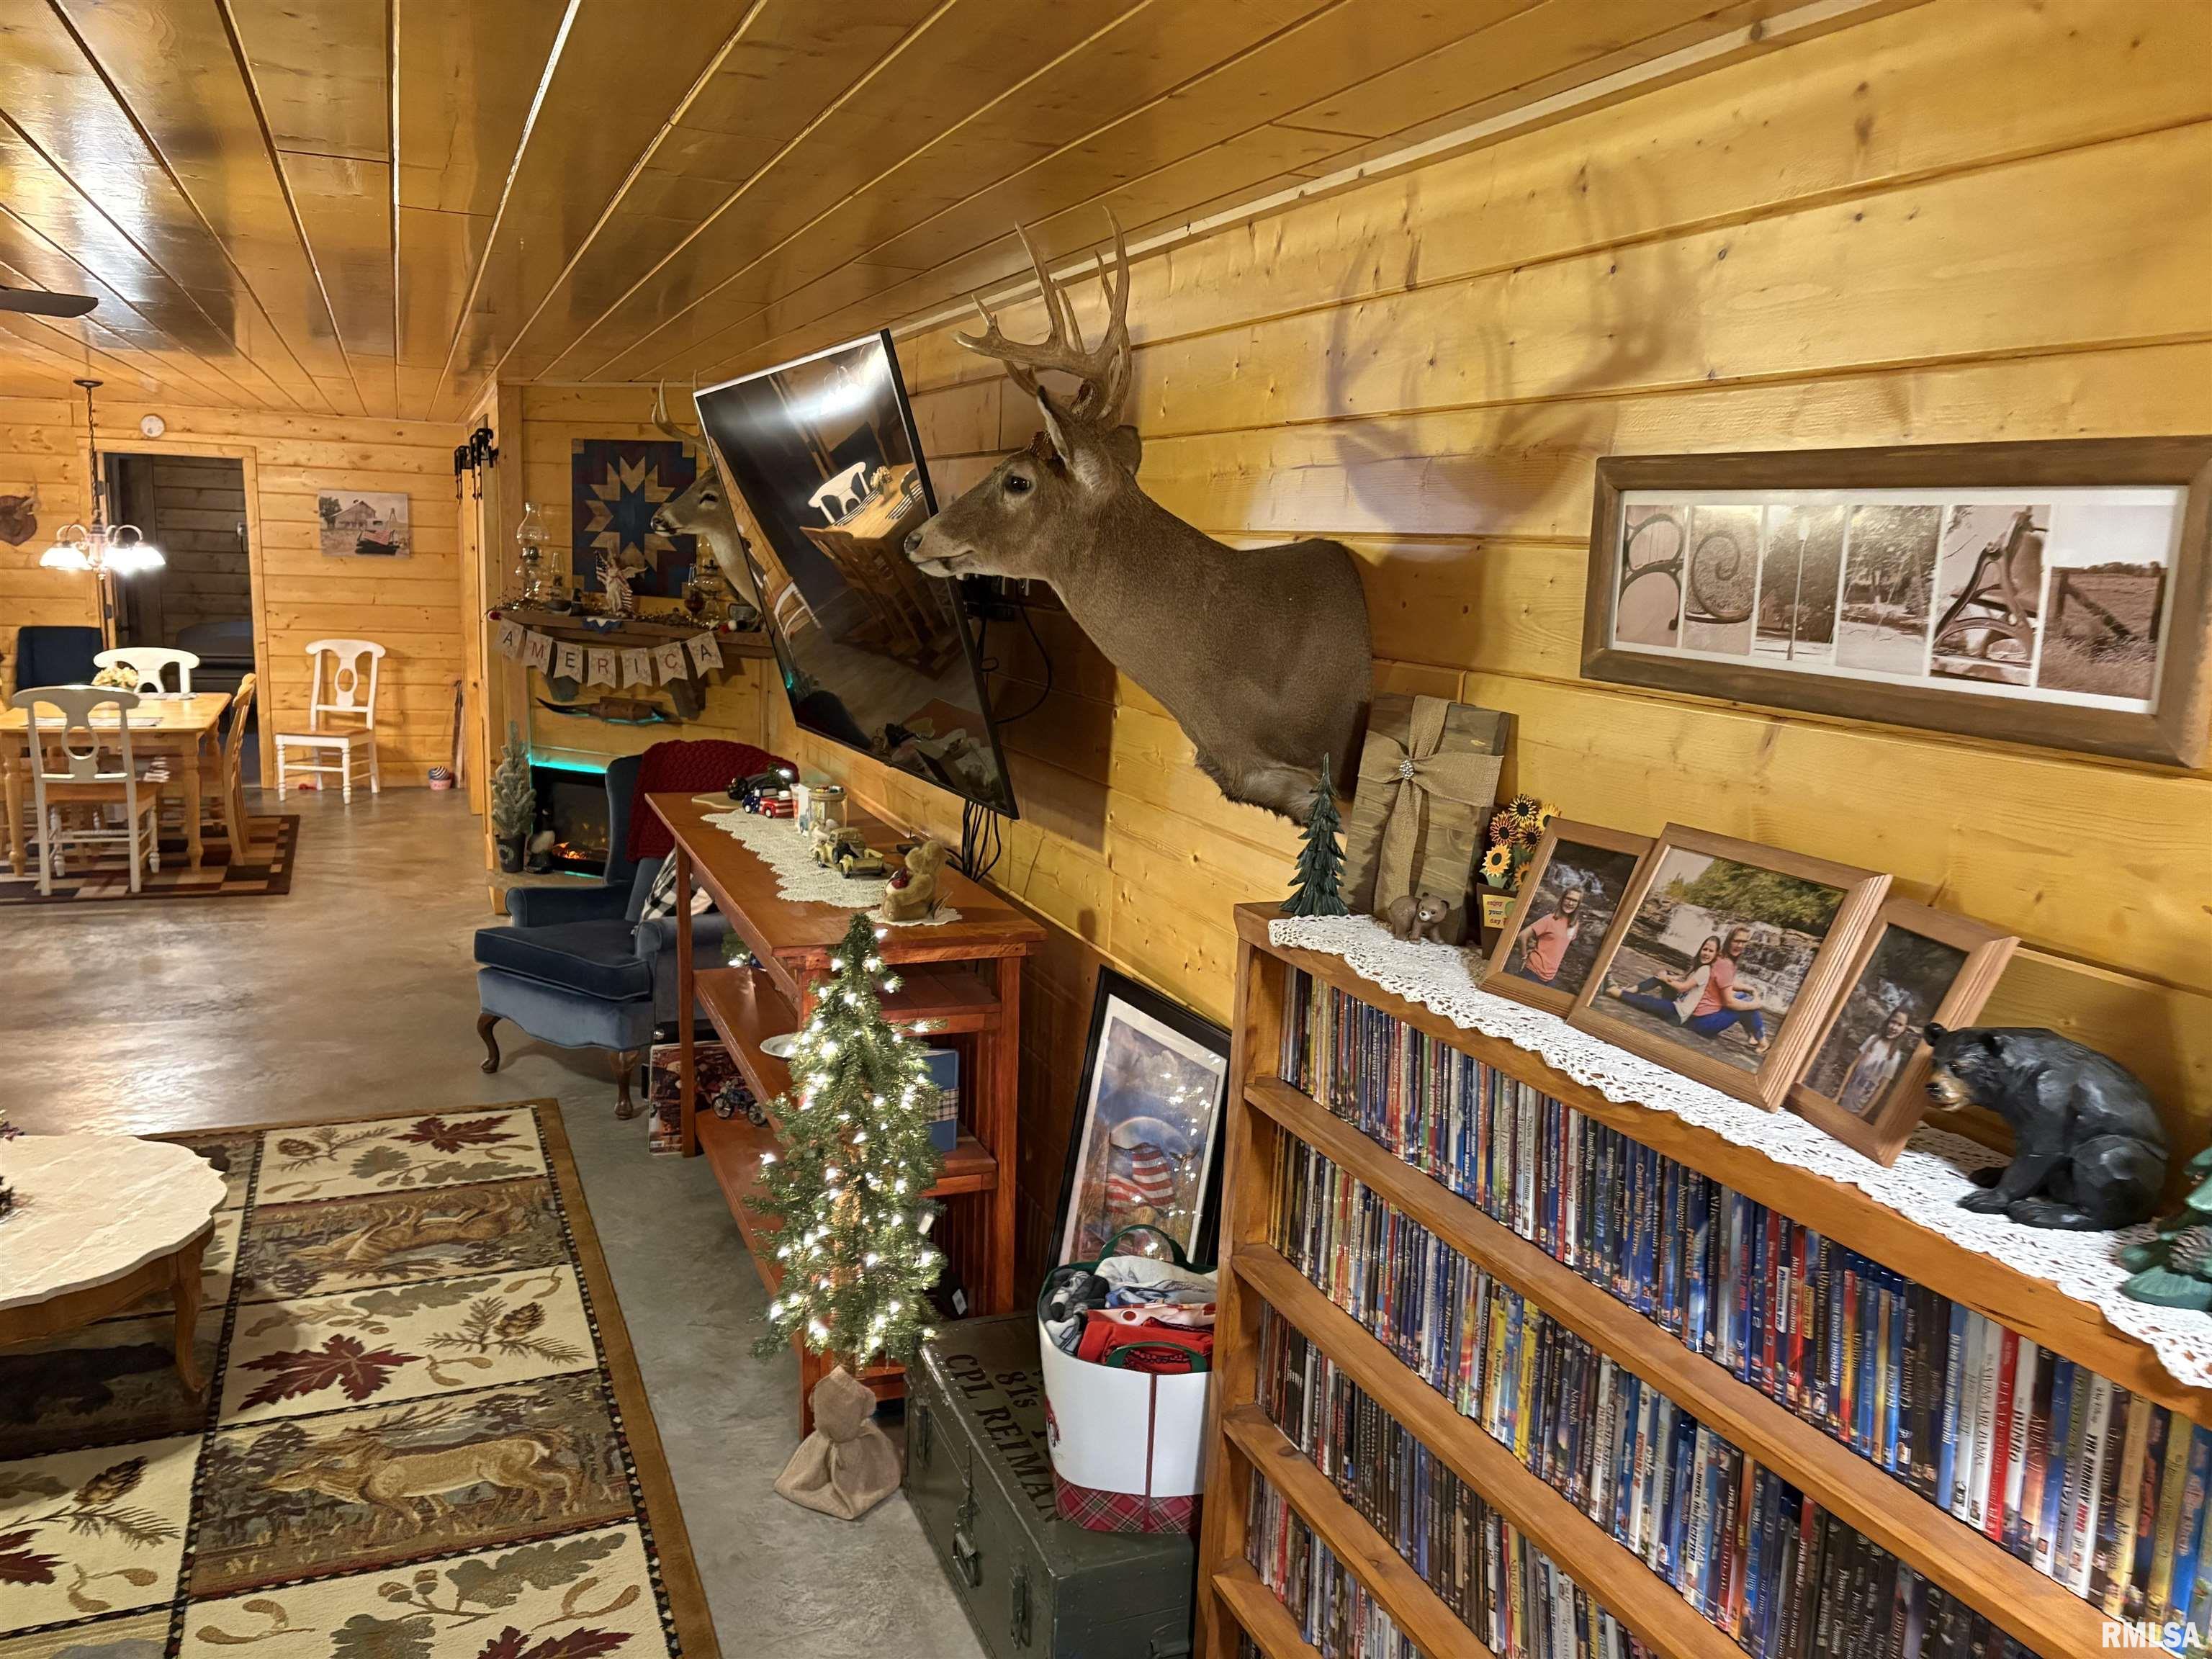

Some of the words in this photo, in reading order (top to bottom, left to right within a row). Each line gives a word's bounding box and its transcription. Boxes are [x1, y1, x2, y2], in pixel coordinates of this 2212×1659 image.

[502, 629, 711, 675] AMERICA
[945, 1354, 994, 1400] CPL
[1830, 1342, 1839, 1387] DINOSAUR
[2009, 1408, 2025, 1463] DUMBO
